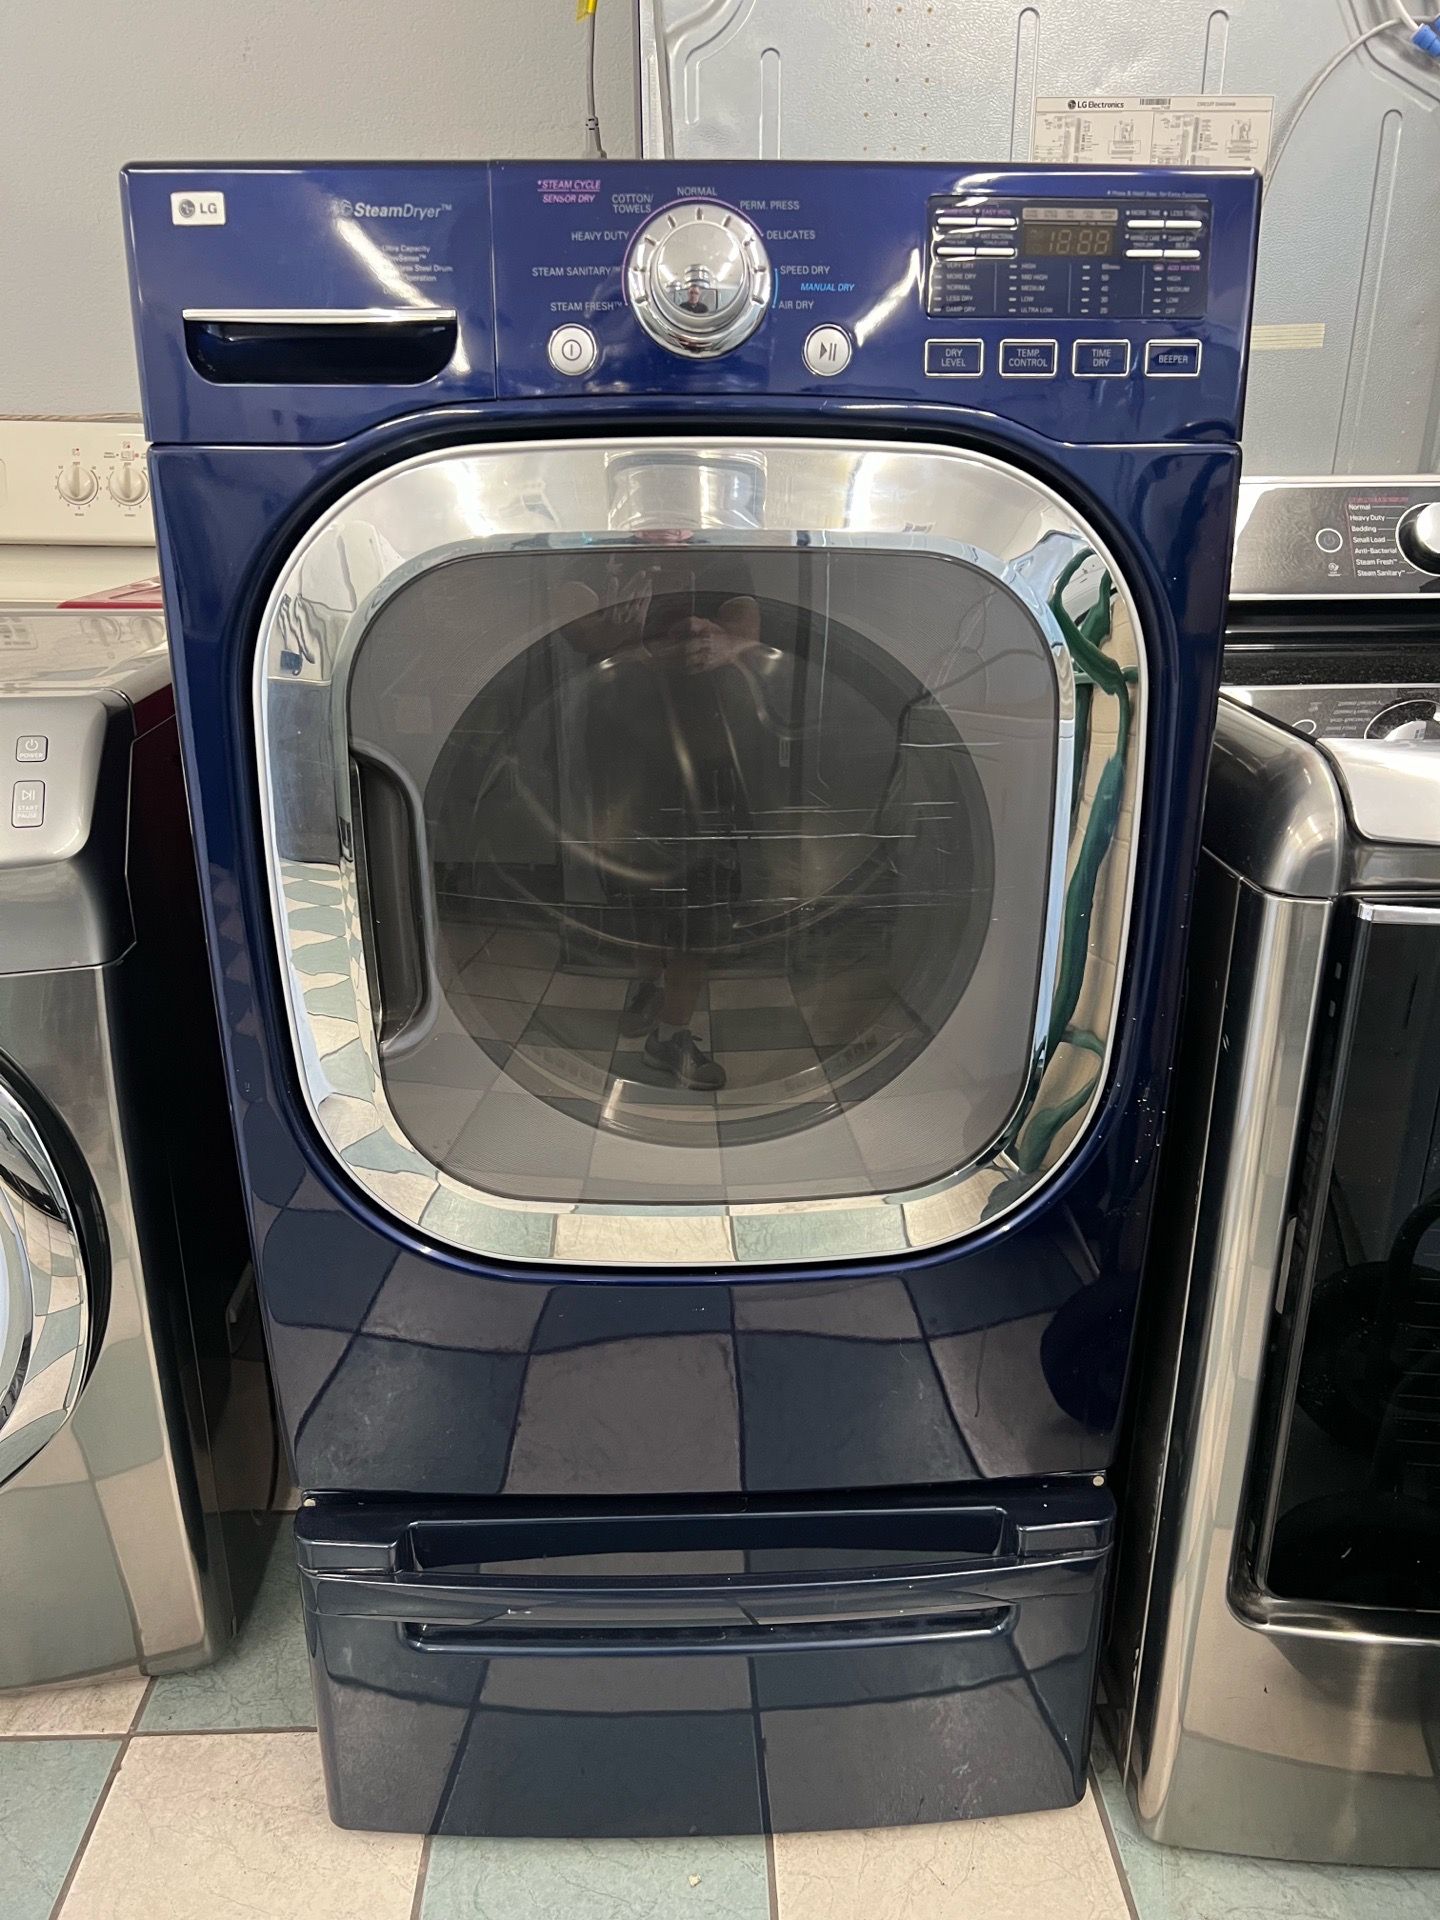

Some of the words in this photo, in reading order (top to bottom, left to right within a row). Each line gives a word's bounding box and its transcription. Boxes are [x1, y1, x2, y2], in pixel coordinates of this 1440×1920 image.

[1088, 101, 1124, 109] Electronics
[574, 180, 600, 189] CYCLE
[677, 186, 717, 196] NORMAL
[543, 193, 577, 203] SENSOR
[578, 193, 595, 203] DRY
[611, 193, 654, 204] COTTON/
[199, 203, 217, 214] LG
[613, 204, 651, 214] TOWELS
[740, 200, 768, 210] PERM.
[770, 200, 800, 210] PRESS
[571, 232, 602, 241] HEAVY
[604, 231, 629, 240] DUTY
[766, 230, 816, 240] DELICATES
[415, 264, 432, 272] Steel
[433, 264, 453, 272] Drum
[532, 267, 564, 277] STEAM
[780, 265, 809, 275] SPEED
[811, 265, 830, 275] DRY
[800, 283, 835, 292] MANUAL
[837, 283, 855, 292] DRY
[550, 302, 582, 312] STEAM
[779, 300, 794, 309] AIR
[795, 300, 814, 309] DRY
[945, 348, 963, 357] DRY
[1017, 348, 1040, 357] TEMP.
[1092, 348, 1112, 357] TIME
[941, 358, 966, 367] LEVEL
[1008, 358, 1048, 367] CONTROL
[1092, 358, 1110, 367] DRY
[1158, 354, 1189, 364] BEEPER
